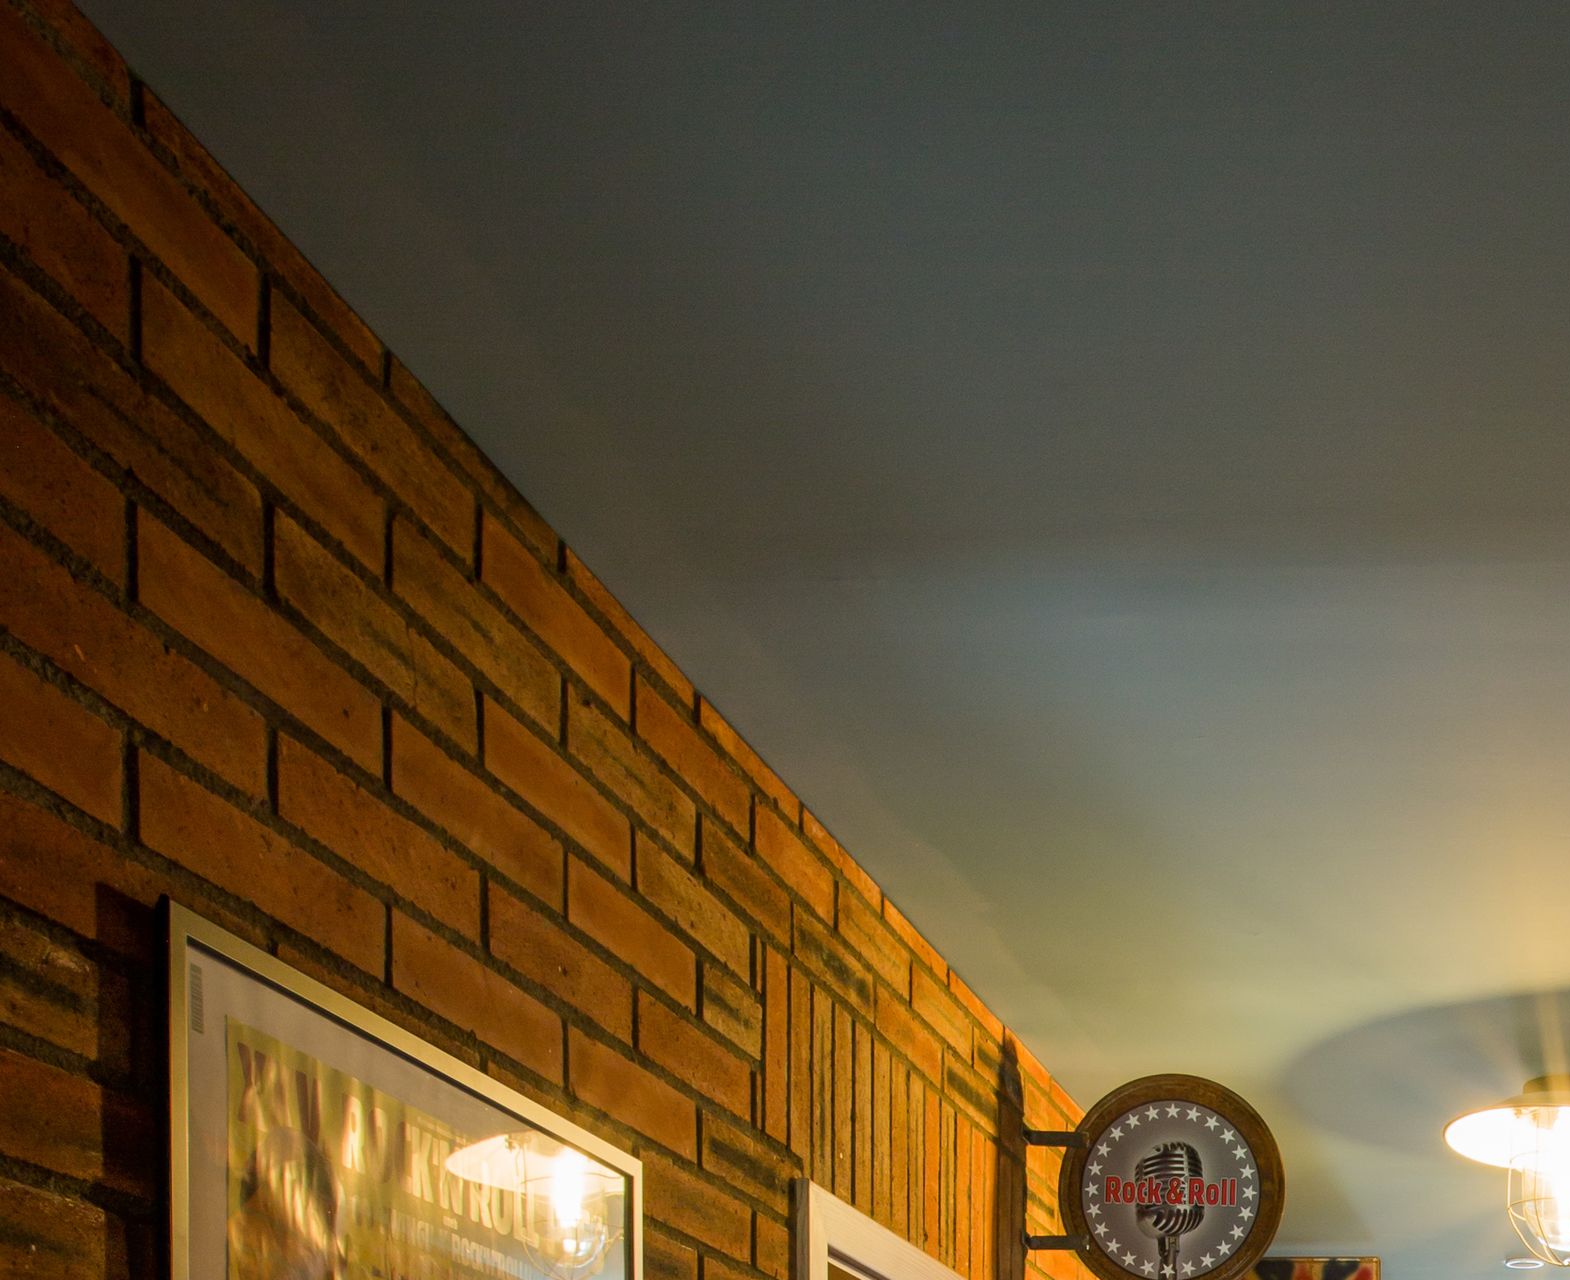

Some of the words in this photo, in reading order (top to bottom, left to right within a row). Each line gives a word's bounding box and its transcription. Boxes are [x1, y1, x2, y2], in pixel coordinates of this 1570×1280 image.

[1104, 1175, 1162, 1205] Rock
[1165, 1177, 1187, 1205] &
[1188, 1177, 1237, 1207] Roll
